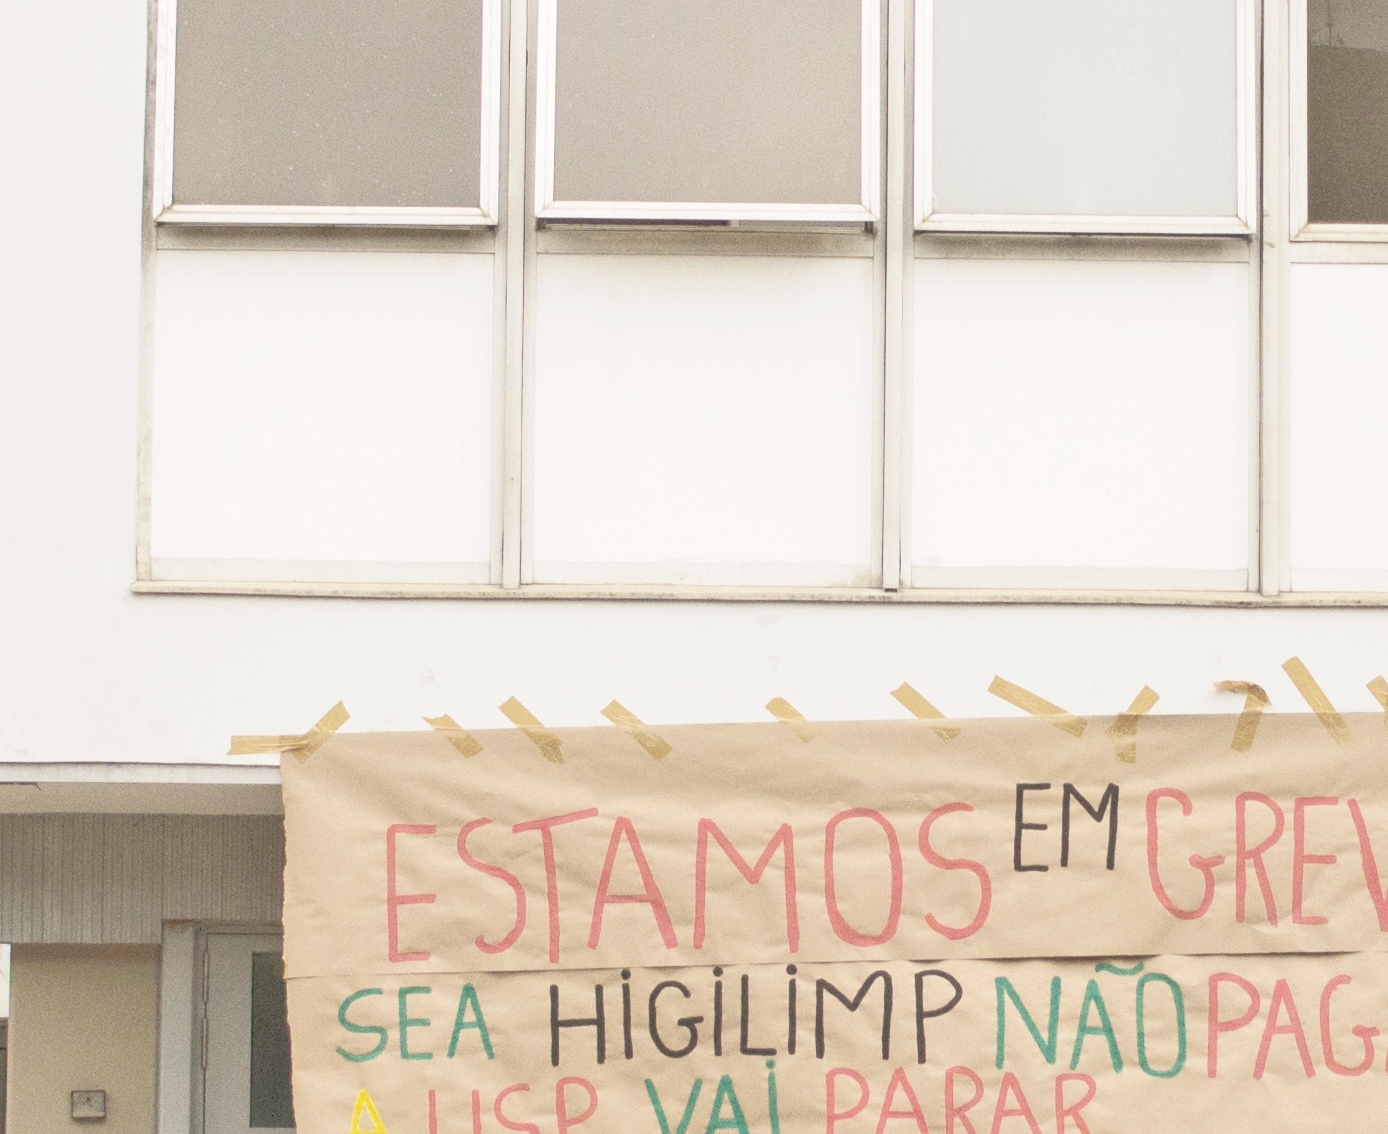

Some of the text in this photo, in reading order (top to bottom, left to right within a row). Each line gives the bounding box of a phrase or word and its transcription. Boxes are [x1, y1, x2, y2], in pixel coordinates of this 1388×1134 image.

[386, 802, 992, 963] ESTAMOS
[1012, 782, 1120, 873] EM
[336, 983, 495, 1064] SEA
[995, 962, 1188, 1078] NÃO
